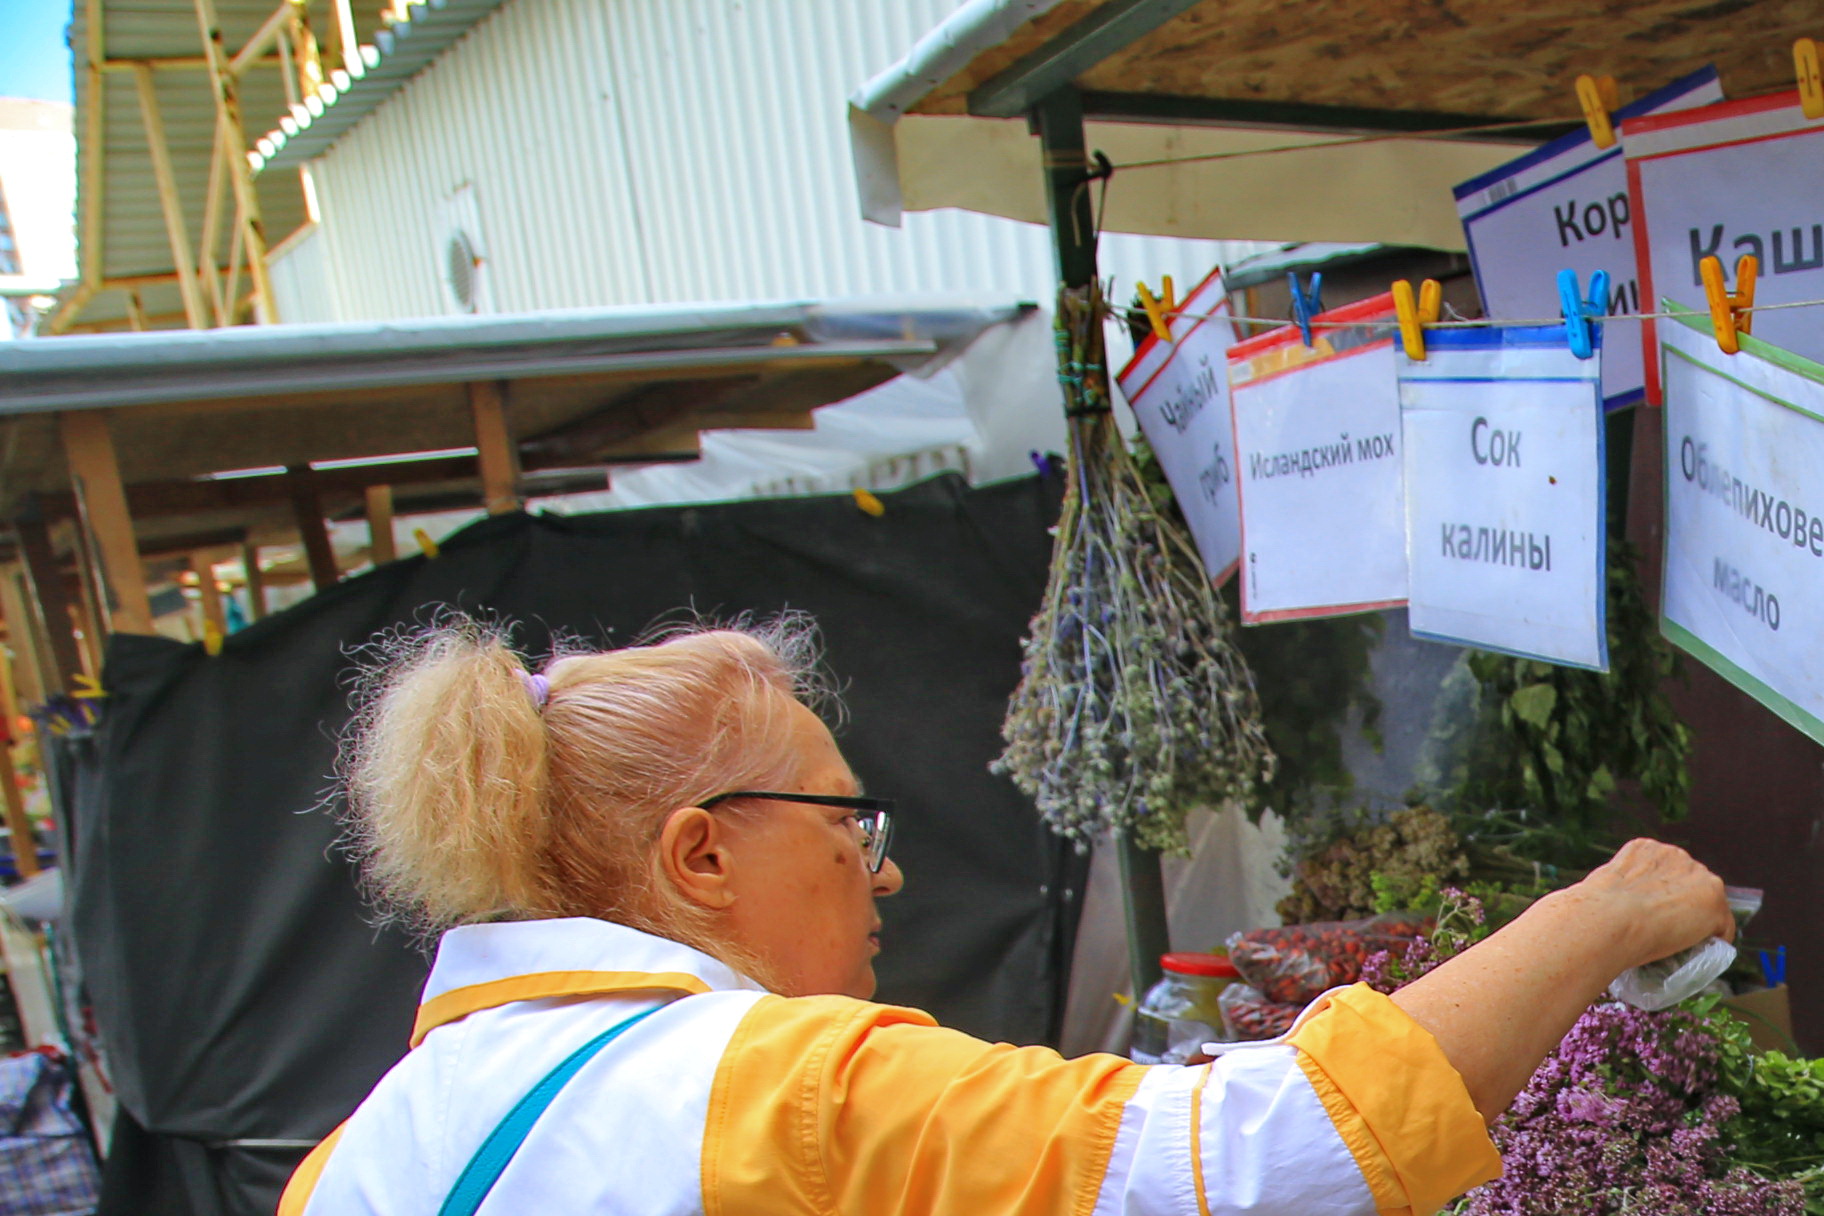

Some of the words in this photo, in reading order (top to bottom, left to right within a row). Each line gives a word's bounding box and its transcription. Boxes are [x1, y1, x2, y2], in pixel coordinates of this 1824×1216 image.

[1250, 431, 1354, 481] Исландский
[1356, 432, 1396, 459] мох
[1469, 414, 1523, 469] Сок
[1440, 519, 1553, 573] калины
[1713, 552, 1781, 632] масло
